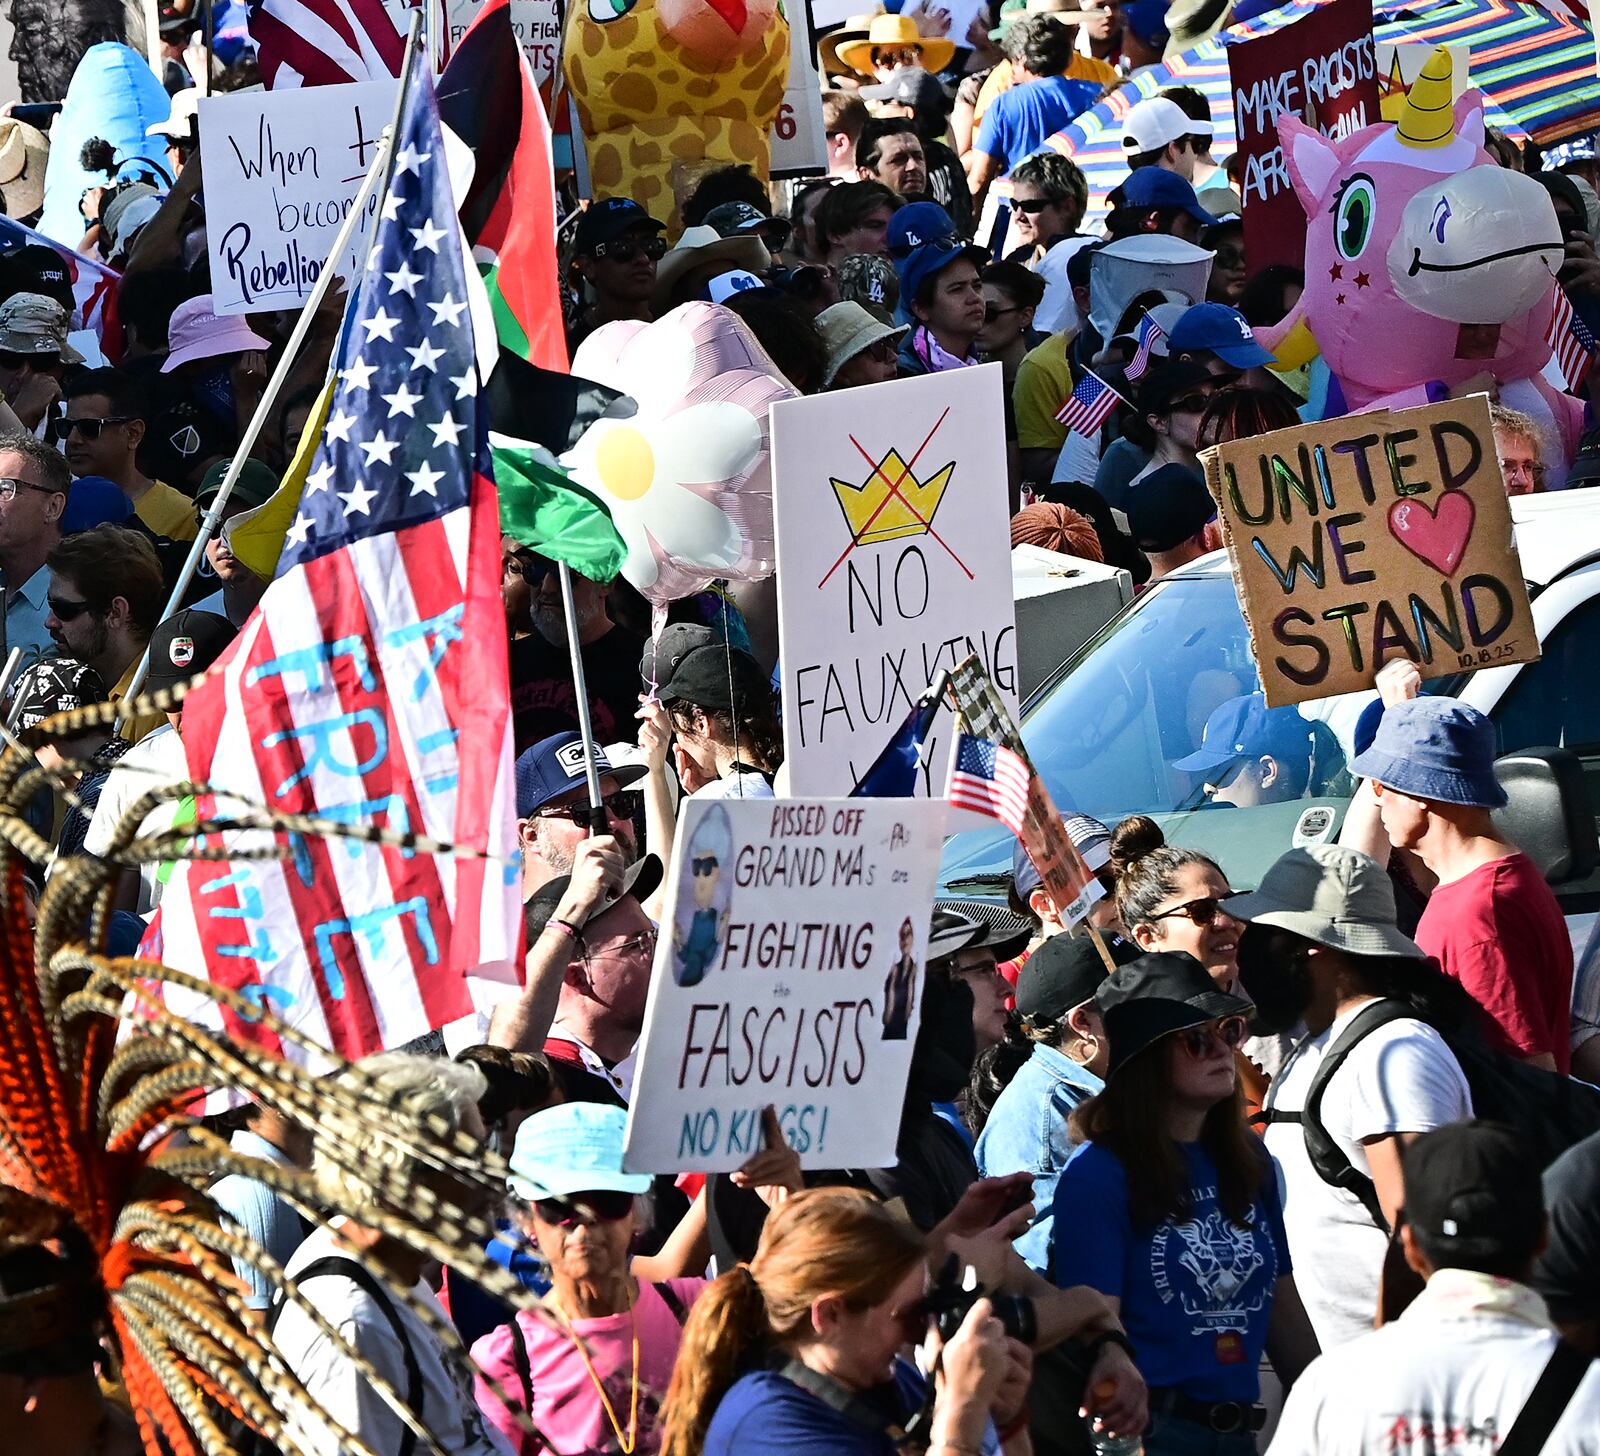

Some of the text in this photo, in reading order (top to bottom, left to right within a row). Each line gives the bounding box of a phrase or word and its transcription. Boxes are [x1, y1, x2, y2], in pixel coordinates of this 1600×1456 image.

[1235, 69, 1302, 141] MAKE
[1302, 32, 1374, 104] RACISTS
[227, 112, 320, 188] When
[905, 230, 922, 247] LA
[869, 277, 885, 303] LA
[1234, 316, 1254, 340] LA
[1224, 418, 1484, 526] UNITED
[847, 544, 930, 634] NO
[1250, 510, 1377, 595] WE
[1271, 573, 1517, 689] STAND
[796, 648, 914, 748] FAUX
[245, 632, 441, 1002] FREE
[769, 803, 866, 839] PISSED OFF
[721, 921, 875, 972] FIGHTING
[677, 997, 875, 1090] FASCISTS
[677, 1106, 720, 1160] NO
[1205, 1315, 1236, 1328] WEST
